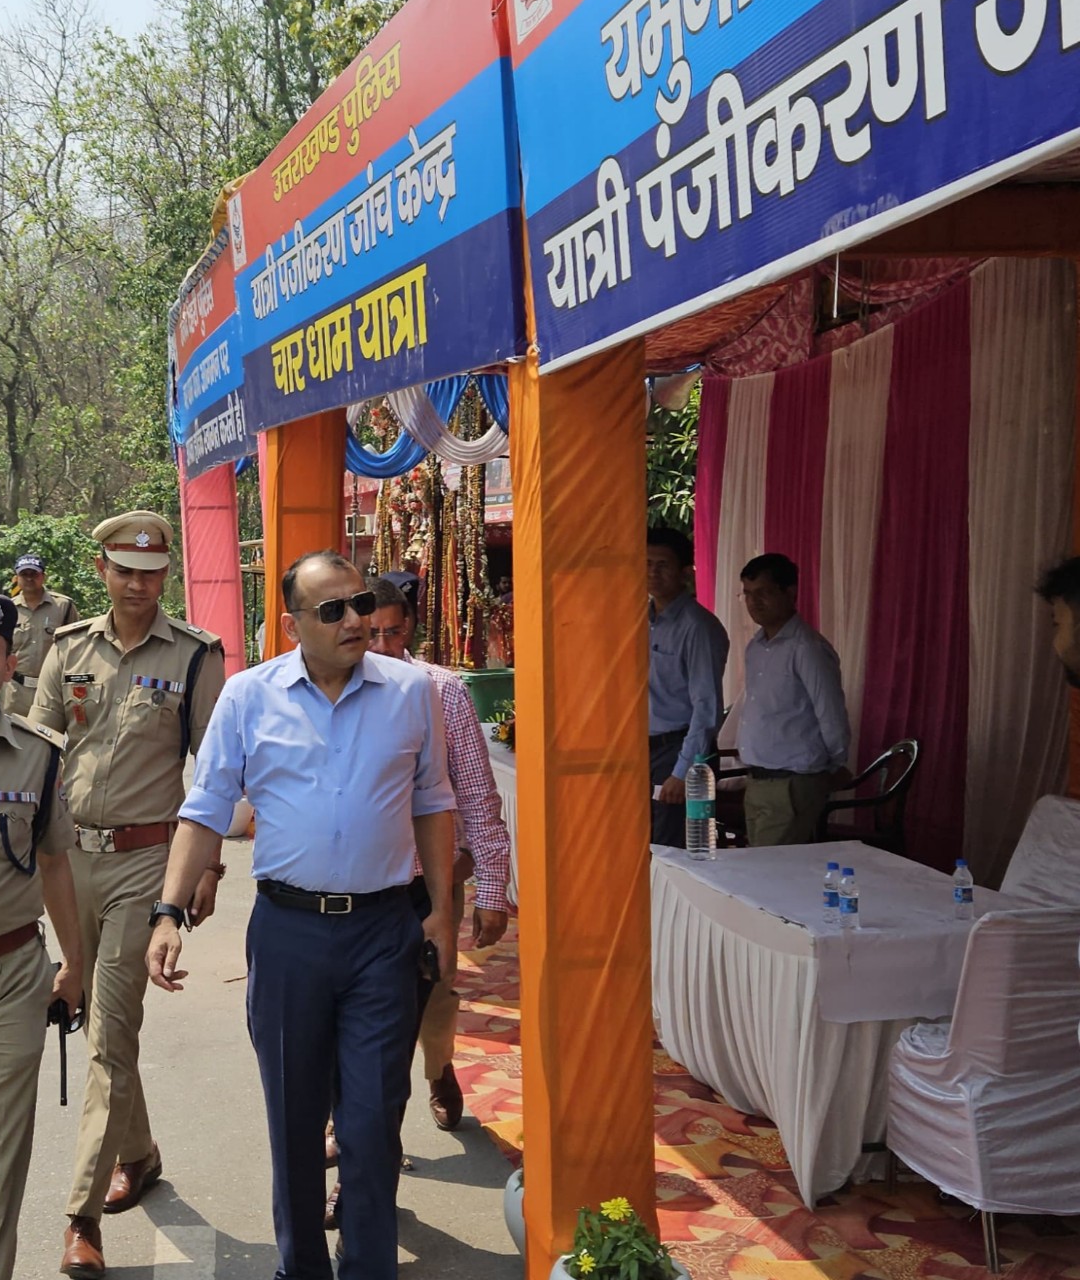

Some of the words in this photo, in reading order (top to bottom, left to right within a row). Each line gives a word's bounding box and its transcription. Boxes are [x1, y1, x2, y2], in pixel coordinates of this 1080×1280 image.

[272, 103, 340, 202] उत्तराखण्ड
[342, 41, 400, 155] पुलिस
[251, 244, 278, 319] यात्री
[277, 207, 347, 300] पंजीकरण
[347, 160, 393, 255] जांच
[395, 120, 456, 225] केन्द्र
[543, 154, 633, 310] यात्री
[272, 329, 305, 395] चार
[306, 303, 353, 381] धाम
[355, 263, 427, 361] यात्रा
